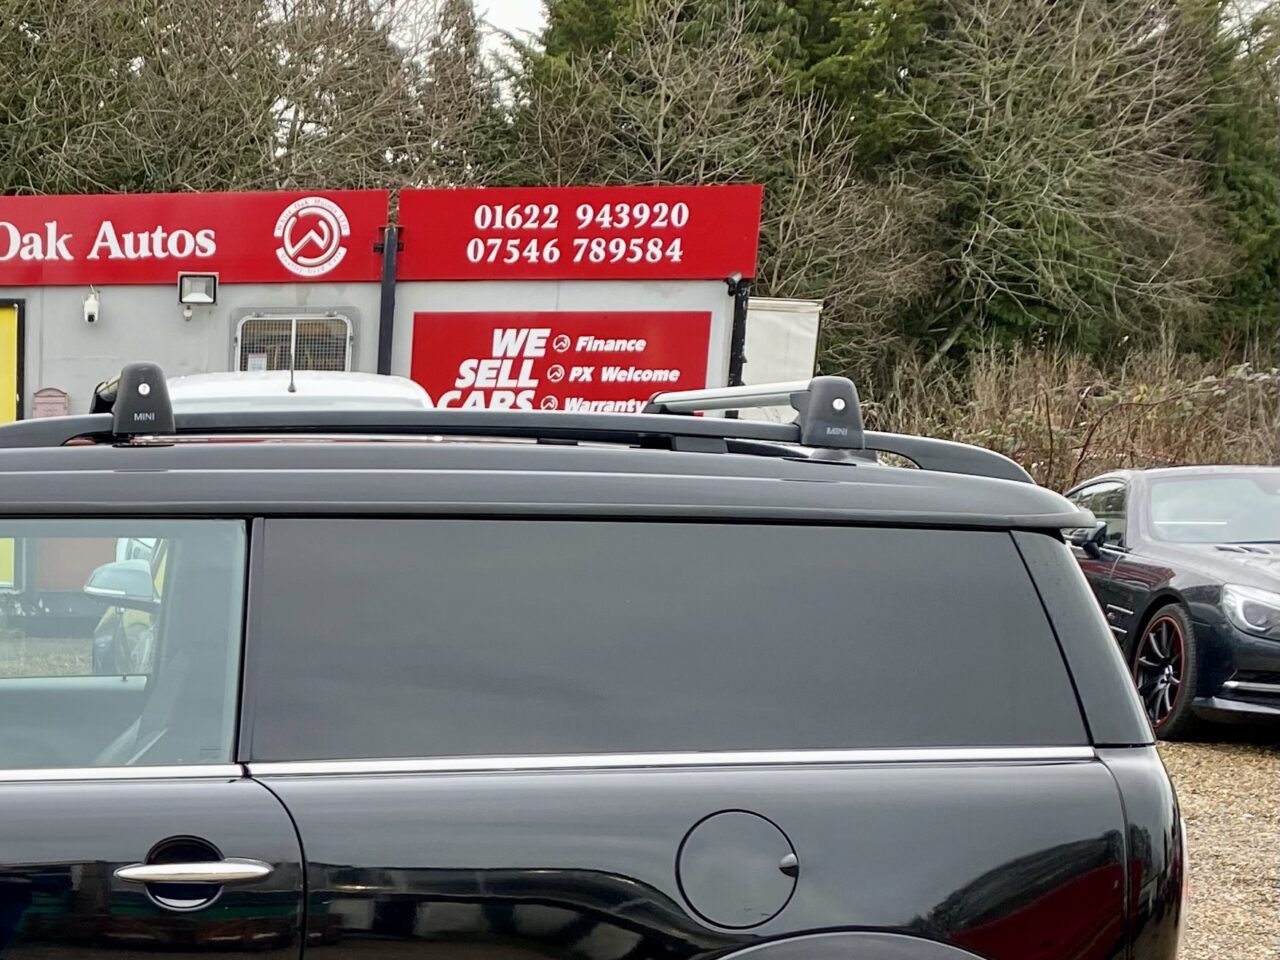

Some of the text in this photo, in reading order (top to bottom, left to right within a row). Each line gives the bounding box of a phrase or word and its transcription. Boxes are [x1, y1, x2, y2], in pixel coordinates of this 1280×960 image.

[474, 202, 690, 230] 01622 943920
[87, 219, 217, 260] Autos
[466, 237, 684, 264] 07546 789584
[491, 328, 552, 358] WE
[575, 336, 648, 353] Finance
[454, 359, 539, 389] SELL
[568, 366, 681, 383] PX Welcome
[436, 390, 536, 410] CARS
[133, 412, 156, 421] MINI
